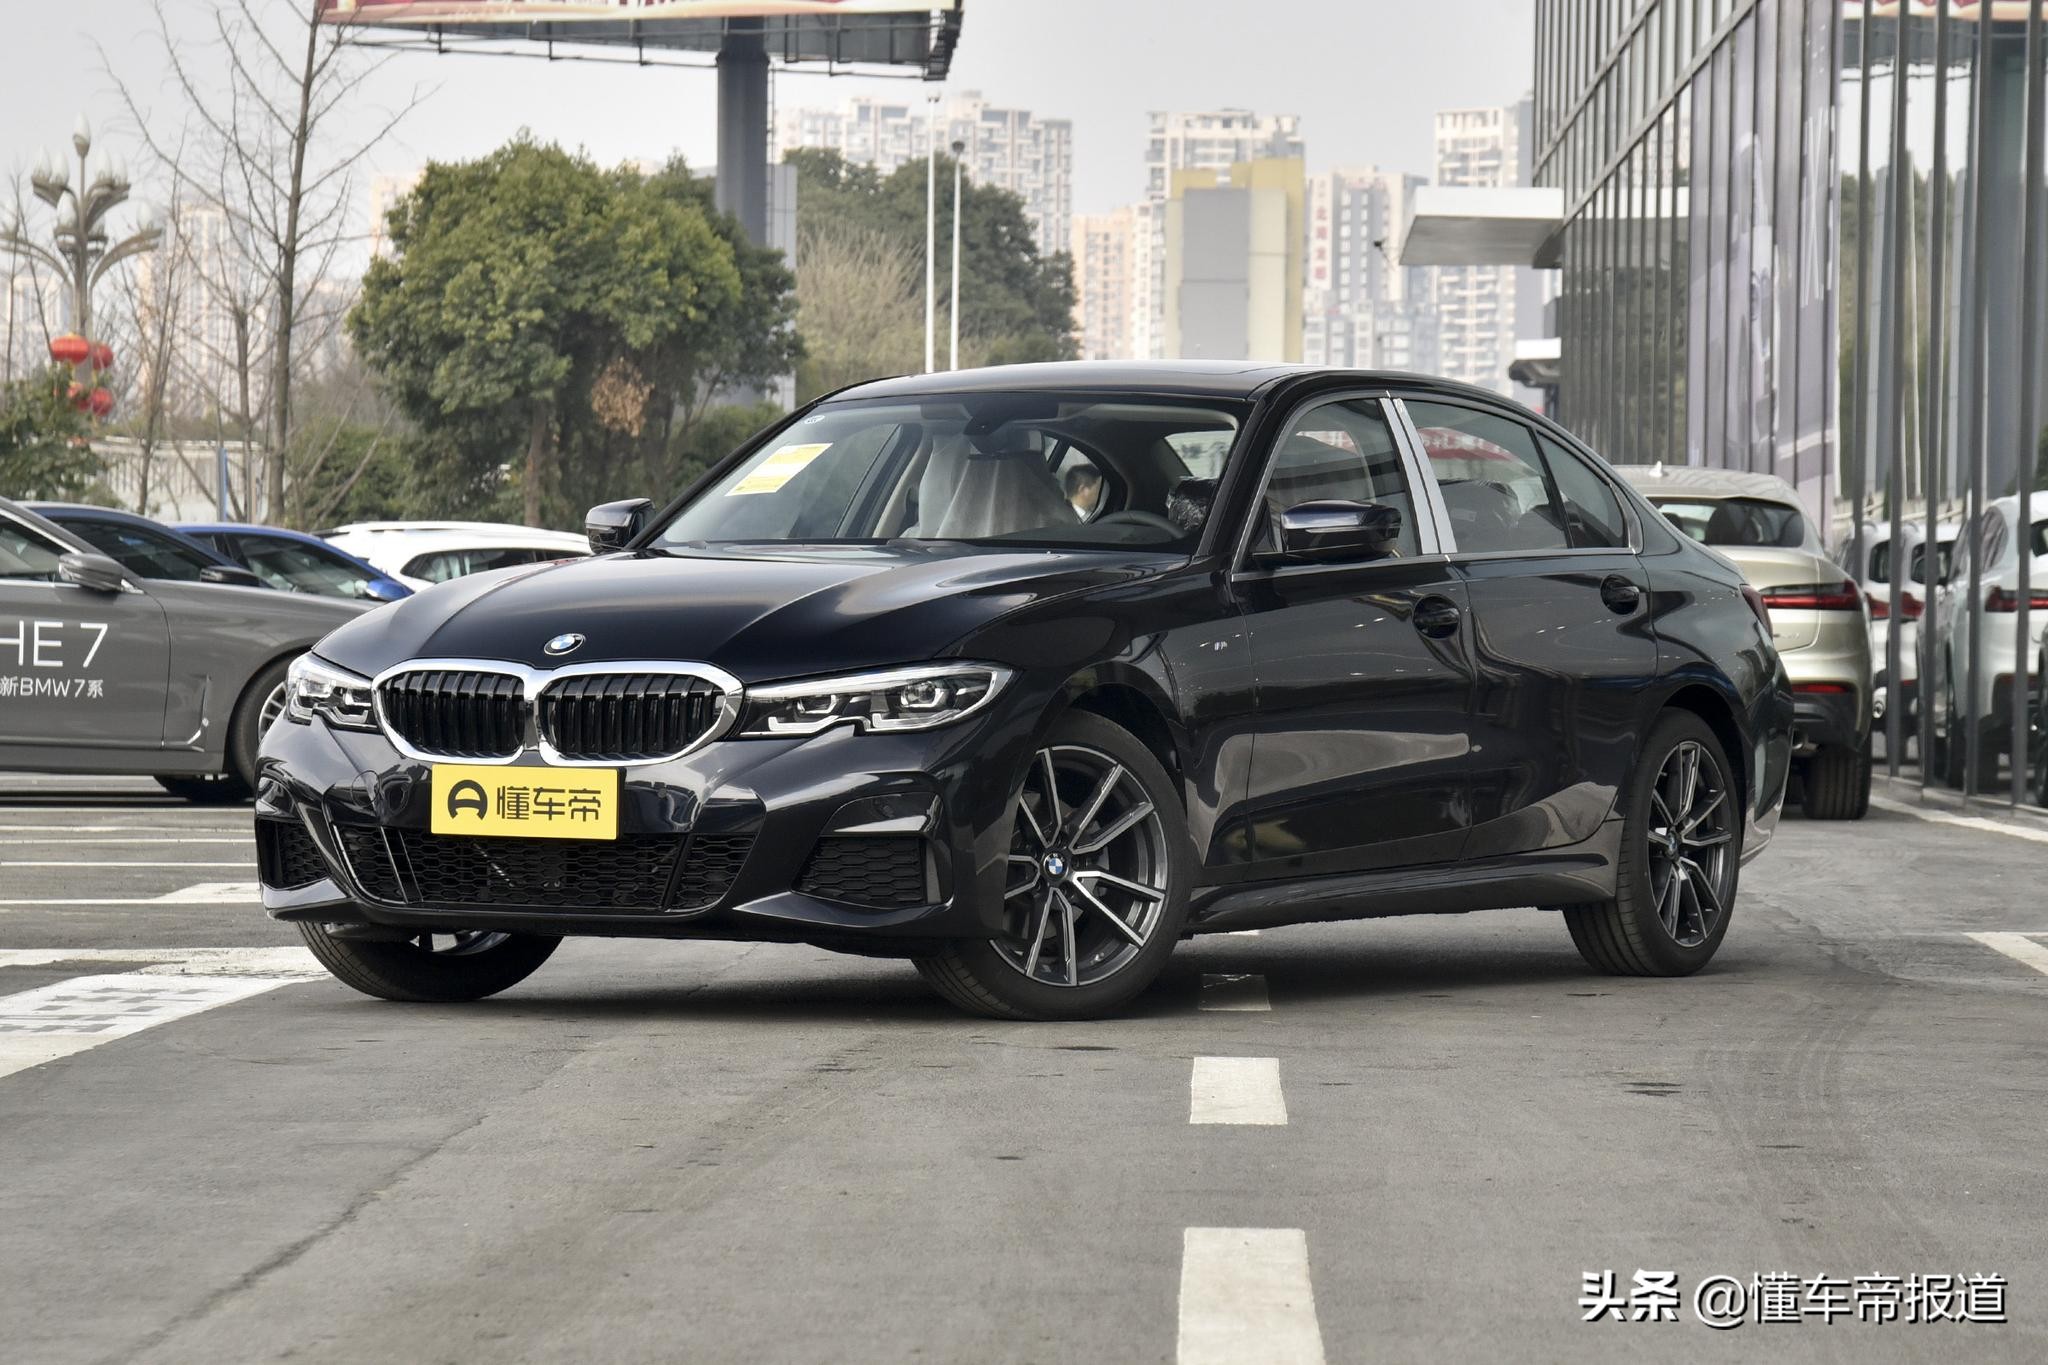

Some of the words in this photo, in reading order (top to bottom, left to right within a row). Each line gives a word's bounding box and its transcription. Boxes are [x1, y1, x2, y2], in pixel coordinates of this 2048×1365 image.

[80, 622, 109, 668] 7
[496, 785, 602, 822] 懂车帝
